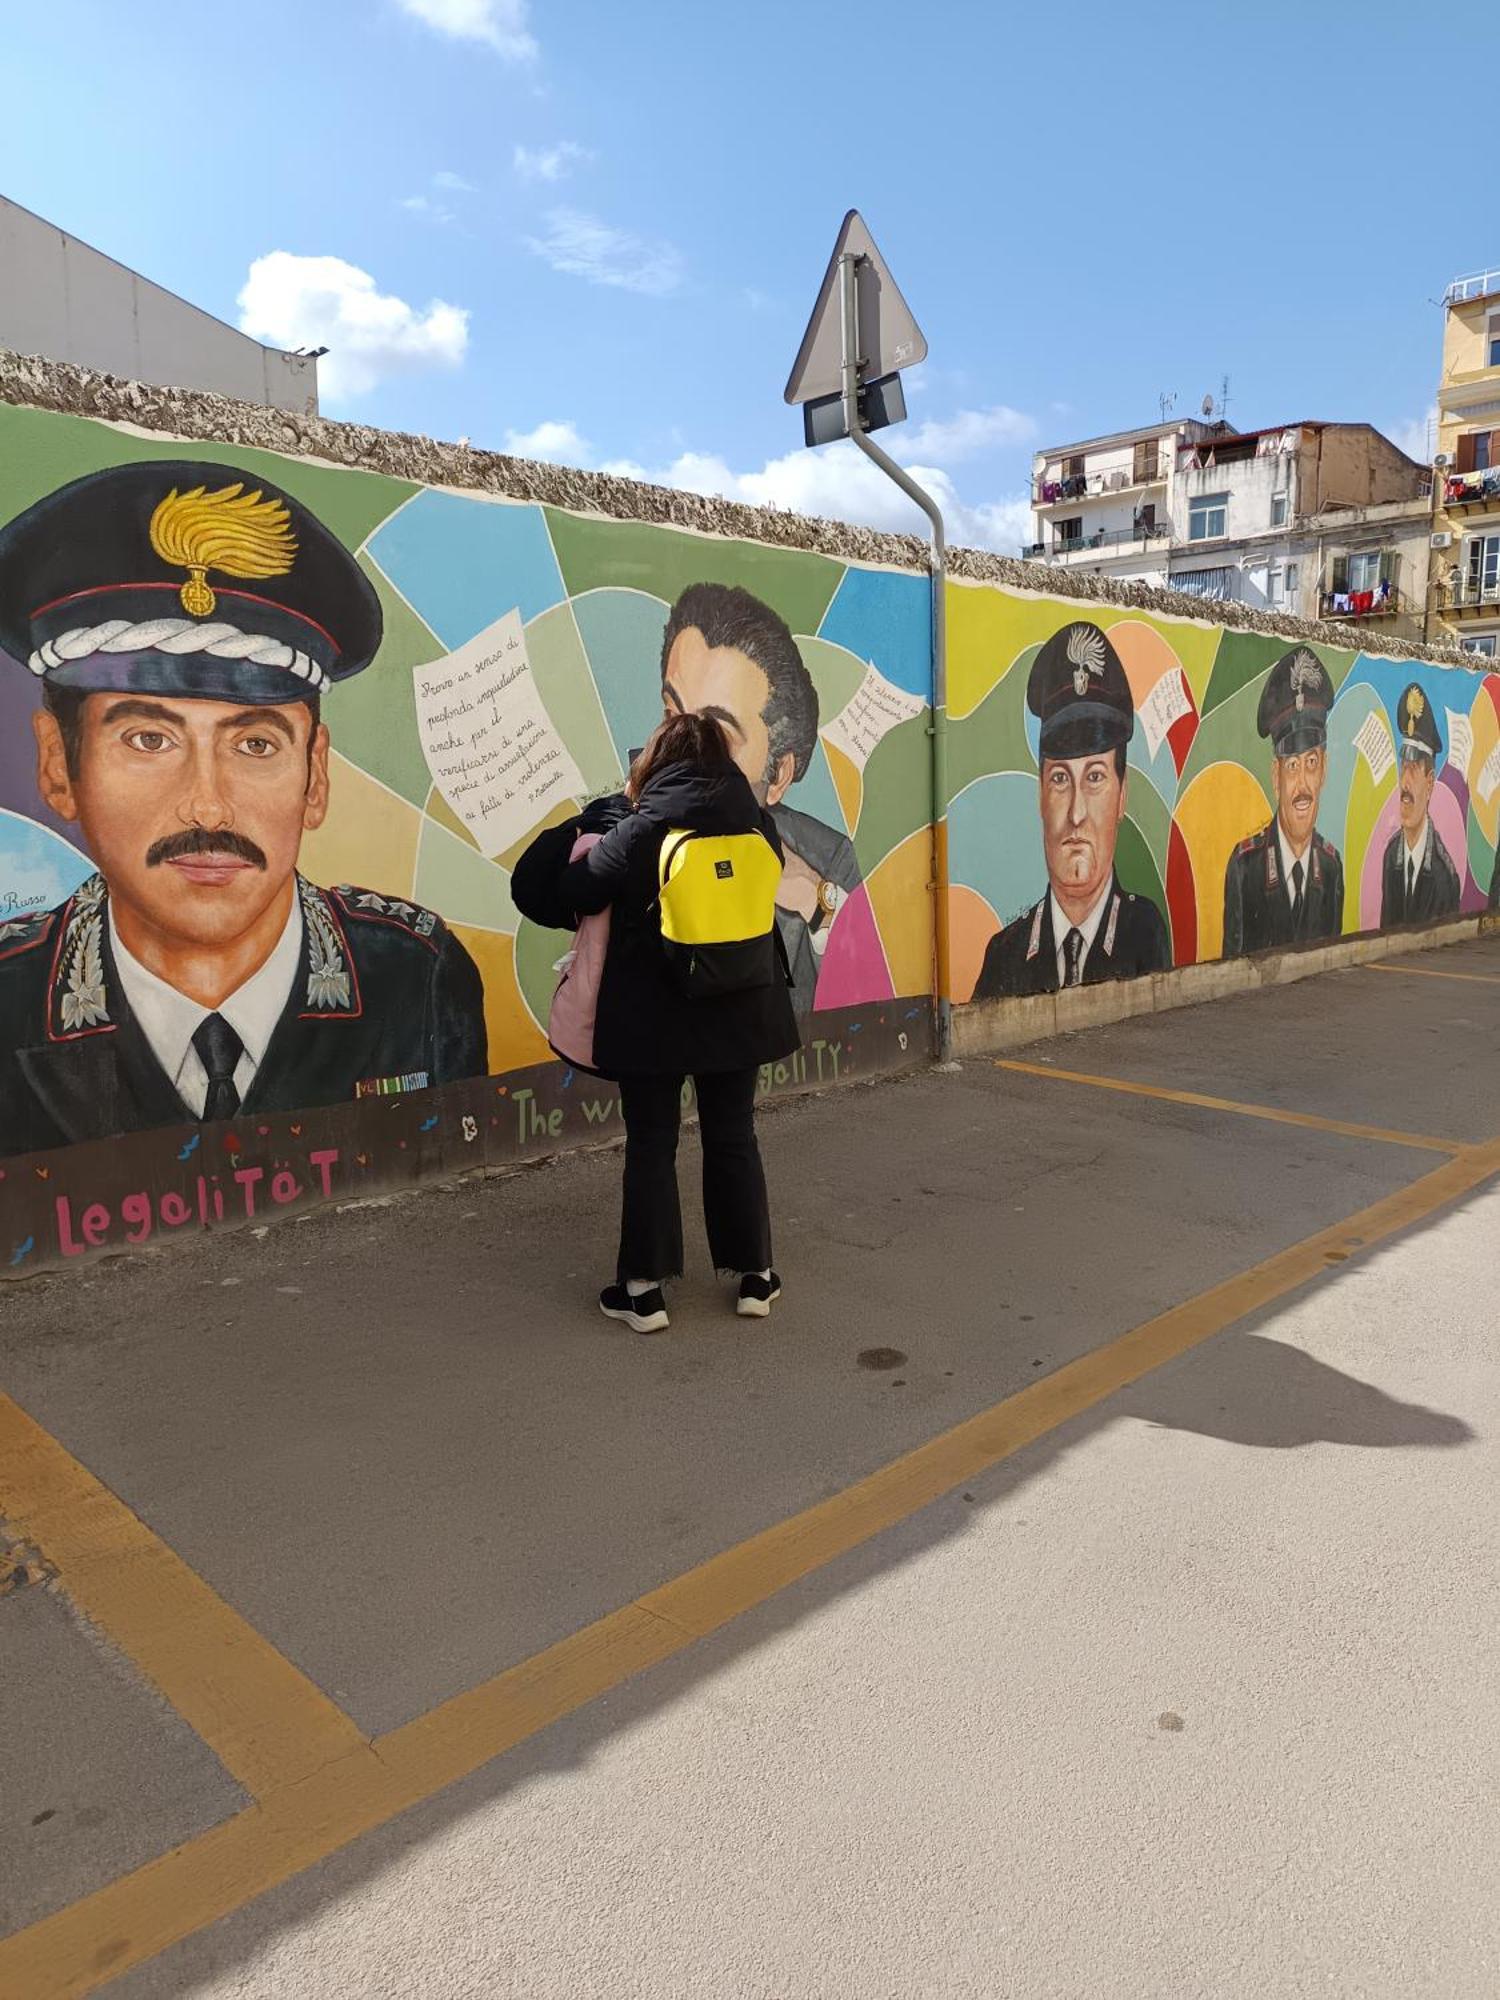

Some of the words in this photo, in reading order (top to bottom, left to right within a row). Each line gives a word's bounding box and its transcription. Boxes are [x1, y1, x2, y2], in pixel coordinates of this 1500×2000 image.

[458, 672, 472, 682] un
[475, 650, 502, 673] senso
[507, 634, 519, 650] di
[427, 700, 474, 731] profonda
[429, 731, 464, 752] anche
[471, 728, 488, 750] per
[491, 707, 502, 726] il
[502, 736, 512, 749] di
[516, 719, 536, 737] una
[449, 780, 480, 800] specie
[484, 770, 496, 783] di
[504, 789, 515, 799] di
[518, 749, 560, 785] violenza
[511, 1088, 564, 1144] The
